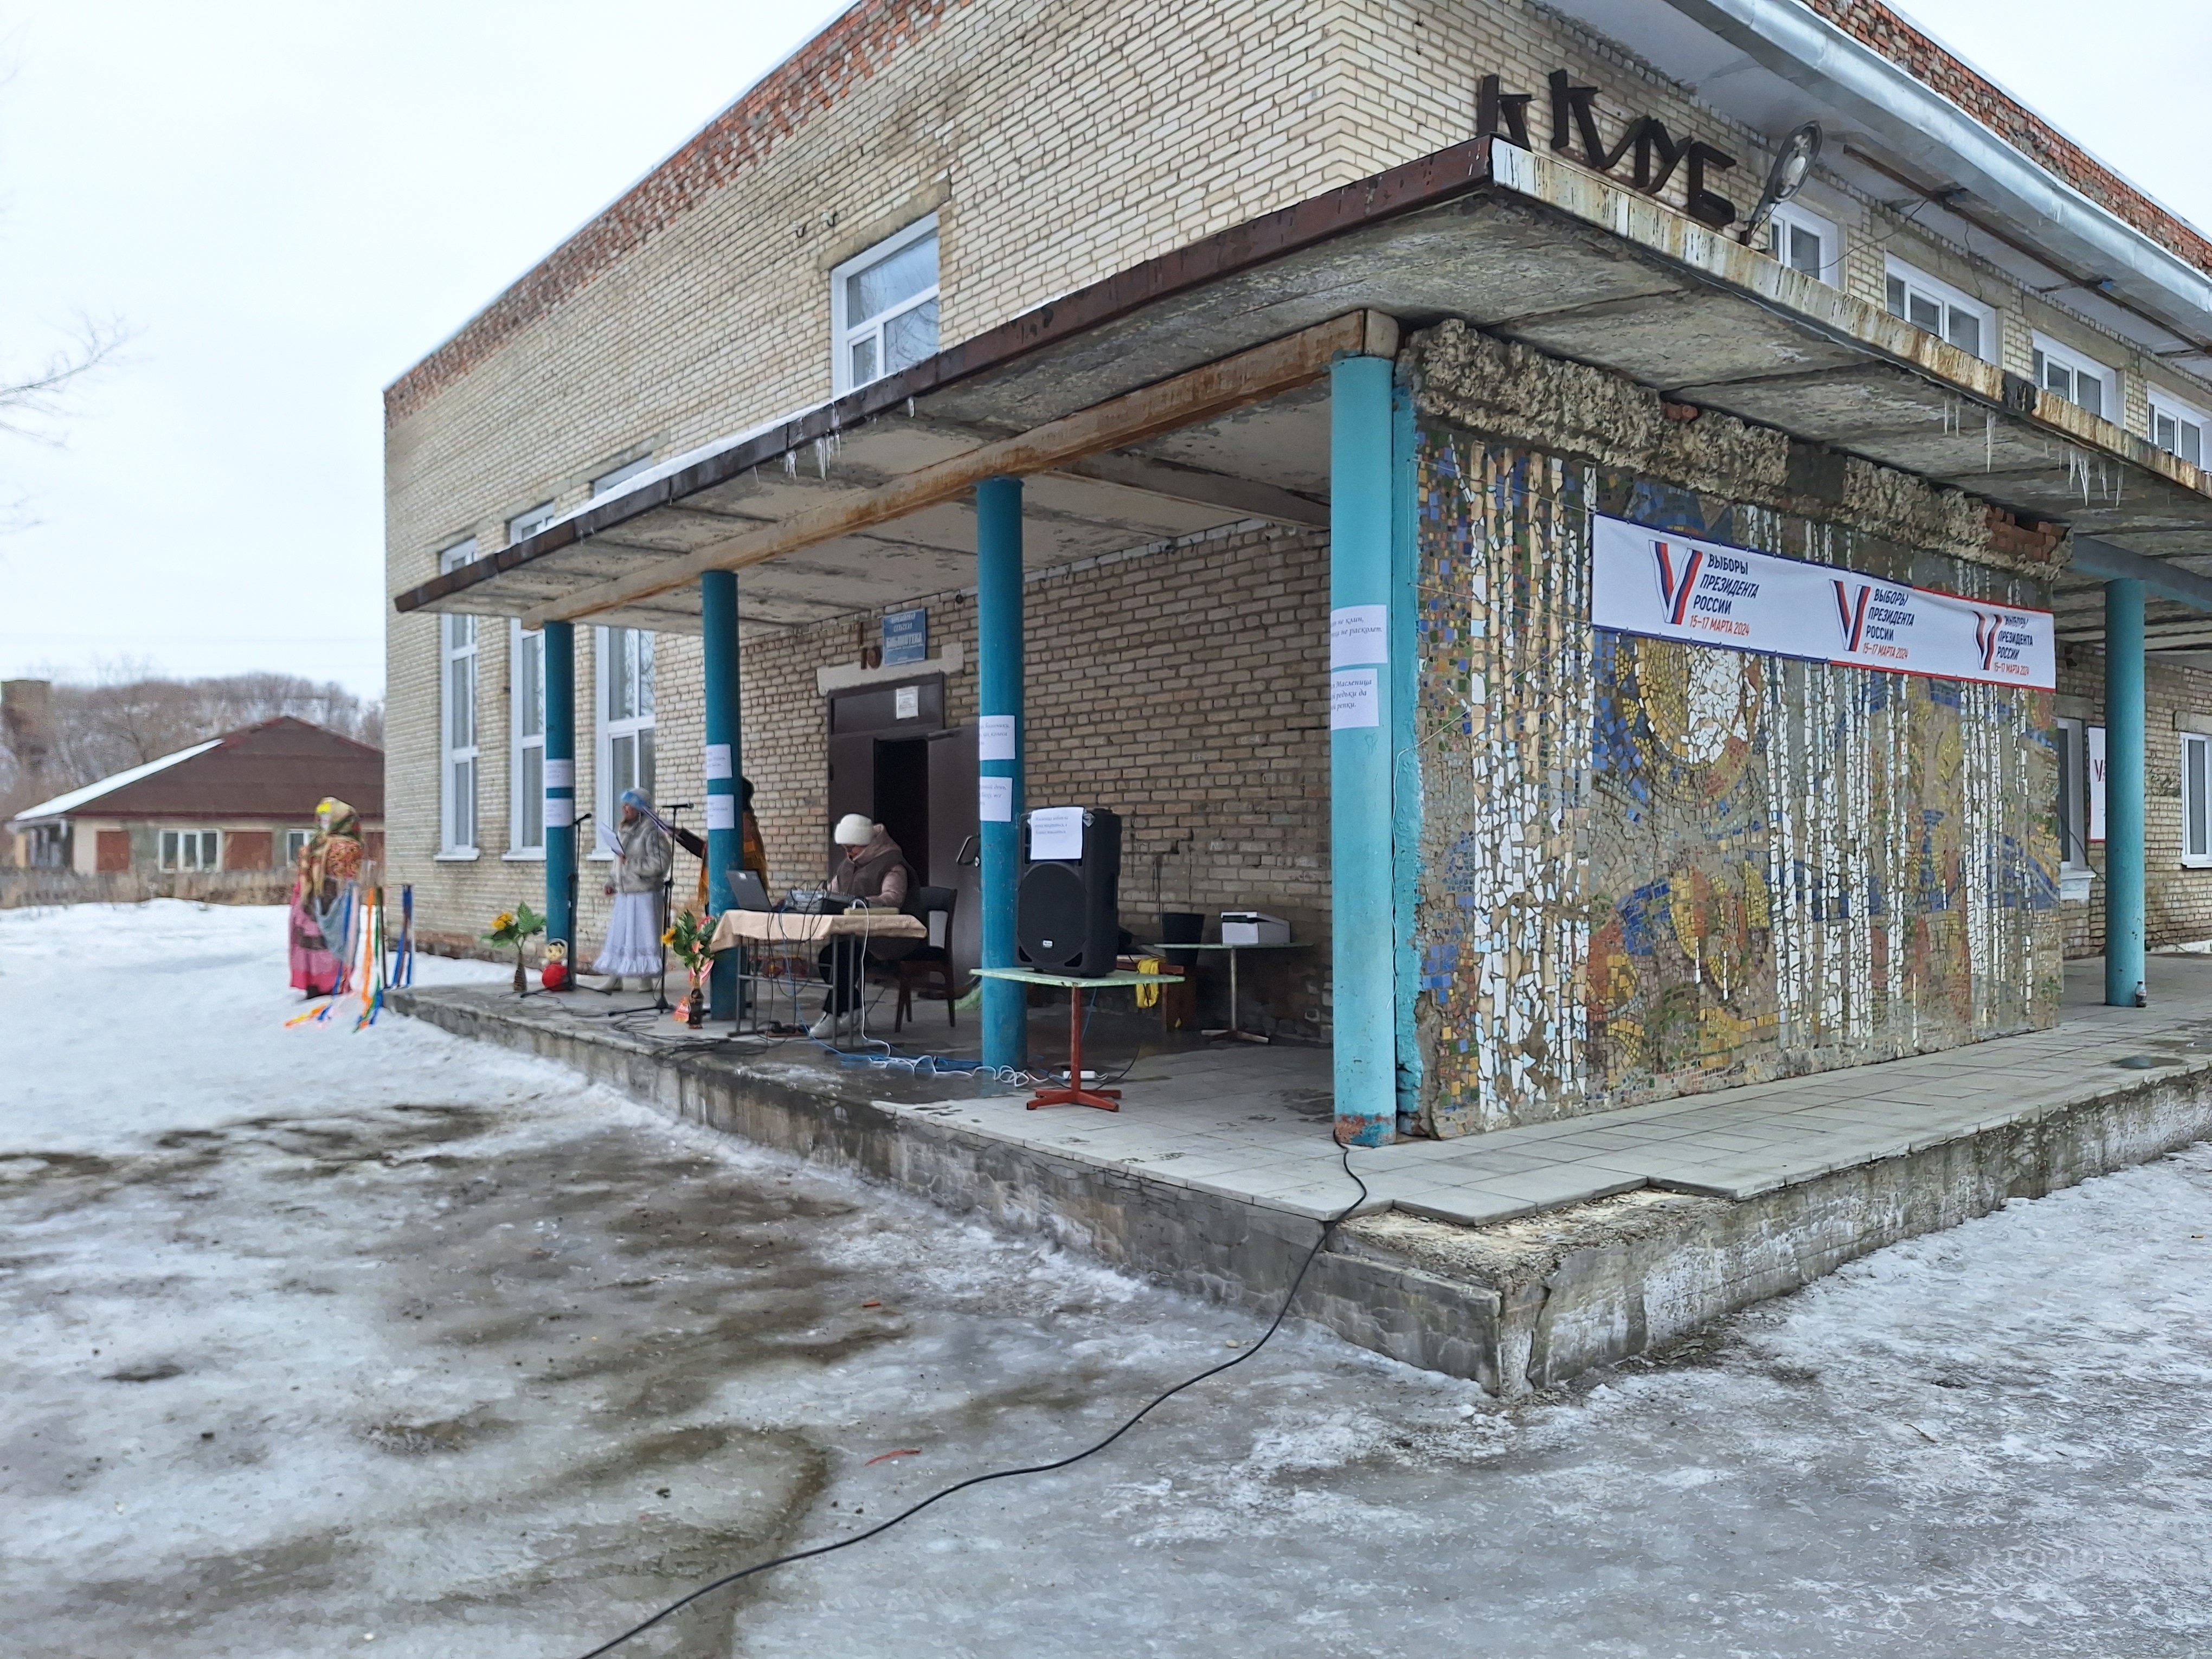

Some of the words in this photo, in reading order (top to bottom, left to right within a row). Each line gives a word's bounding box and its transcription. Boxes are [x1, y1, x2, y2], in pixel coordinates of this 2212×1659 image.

[1707, 553, 1748, 575] ВЫБОРЫ
[1700, 573, 1760, 599] ПРЕЗИДЕНТА
[1693, 594, 1732, 615] РОССИИ
[1874, 588, 1909, 607] ВЫБОРЫ
[1868, 607, 1915, 627] ПРЕЗИДЕНТА
[1710, 618, 1733, 634] МАРТА
[1733, 621, 1750, 636] 2024
[1866, 625, 1894, 641] РОССИИ
[1998, 630, 2034, 646] ПРЕЗИДЕНТА
[1878, 644, 1896, 658] МАРТА
[1895, 647, 1909, 660] 2024
[1996, 646, 2020, 660] РОССИИ
[2005, 663, 2020, 674] МАРТА
[1359, 688, 1367, 696] да
